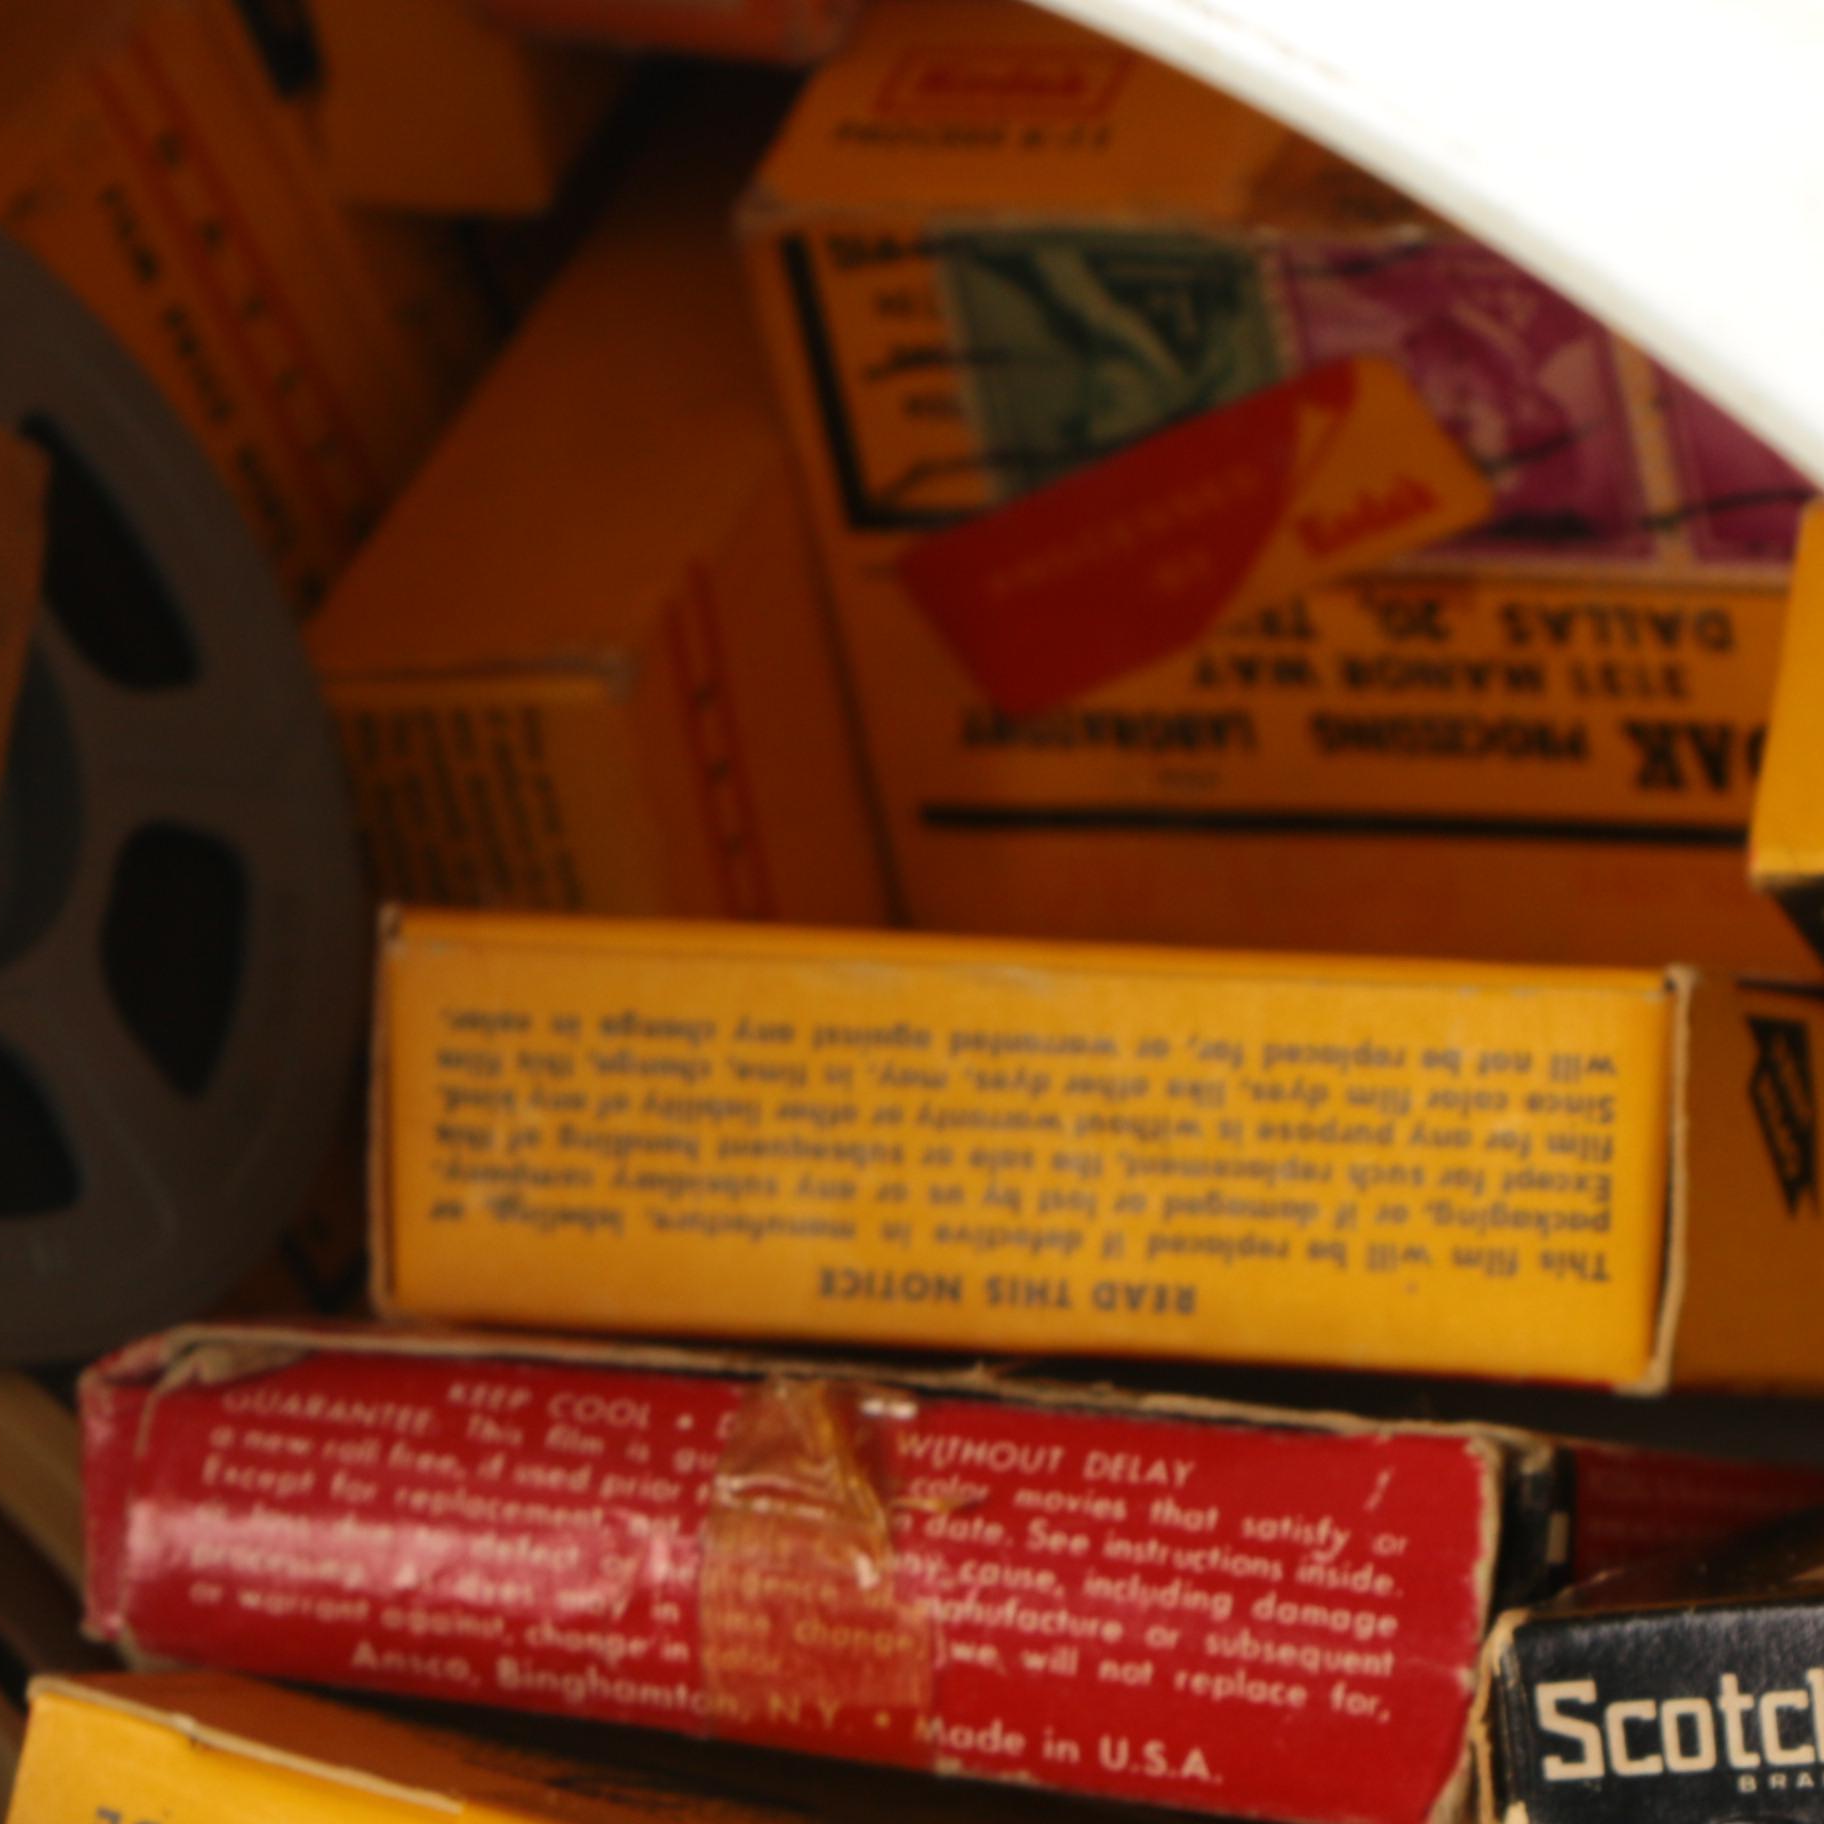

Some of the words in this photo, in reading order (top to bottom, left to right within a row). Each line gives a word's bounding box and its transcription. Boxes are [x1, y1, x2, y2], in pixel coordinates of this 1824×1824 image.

[819, 1268, 960, 1302] NOTICE
[1451, 1249, 1519, 1279] film
[1539, 1251, 1608, 1282] This
[985, 1276, 1072, 1308] THIS
[1093, 1282, 1194, 1315] READ
[897, 1433, 1063, 1472] WITHOUT
[1084, 1451, 1192, 1486] DELAY
[1014, 1489, 1127, 1521] movies
[1149, 1498, 1219, 1531] that
[1241, 1516, 1350, 1563] satisfy
[1373, 1534, 1407, 1555] or
[1029, 1521, 1089, 1553] See
[1103, 1537, 1284, 1581] instructions
[1296, 1556, 1394, 1595] inside.
[1083, 1575, 1234, 1620] including
[1251, 1595, 1398, 1640] damage
[1146, 1626, 1181, 1651] or
[1204, 1631, 1395, 1676] subsequent
[1022, 1648, 1077, 1673] will
[1098, 1660, 1153, 1684] not
[1175, 1670, 1308, 1708] replace
[1330, 1685, 1389, 1721] for,
[916, 1717, 1025, 1755] Made
[1043, 1728, 1081, 1763] in
[1098, 1734, 1222, 1785] U.S.A.
